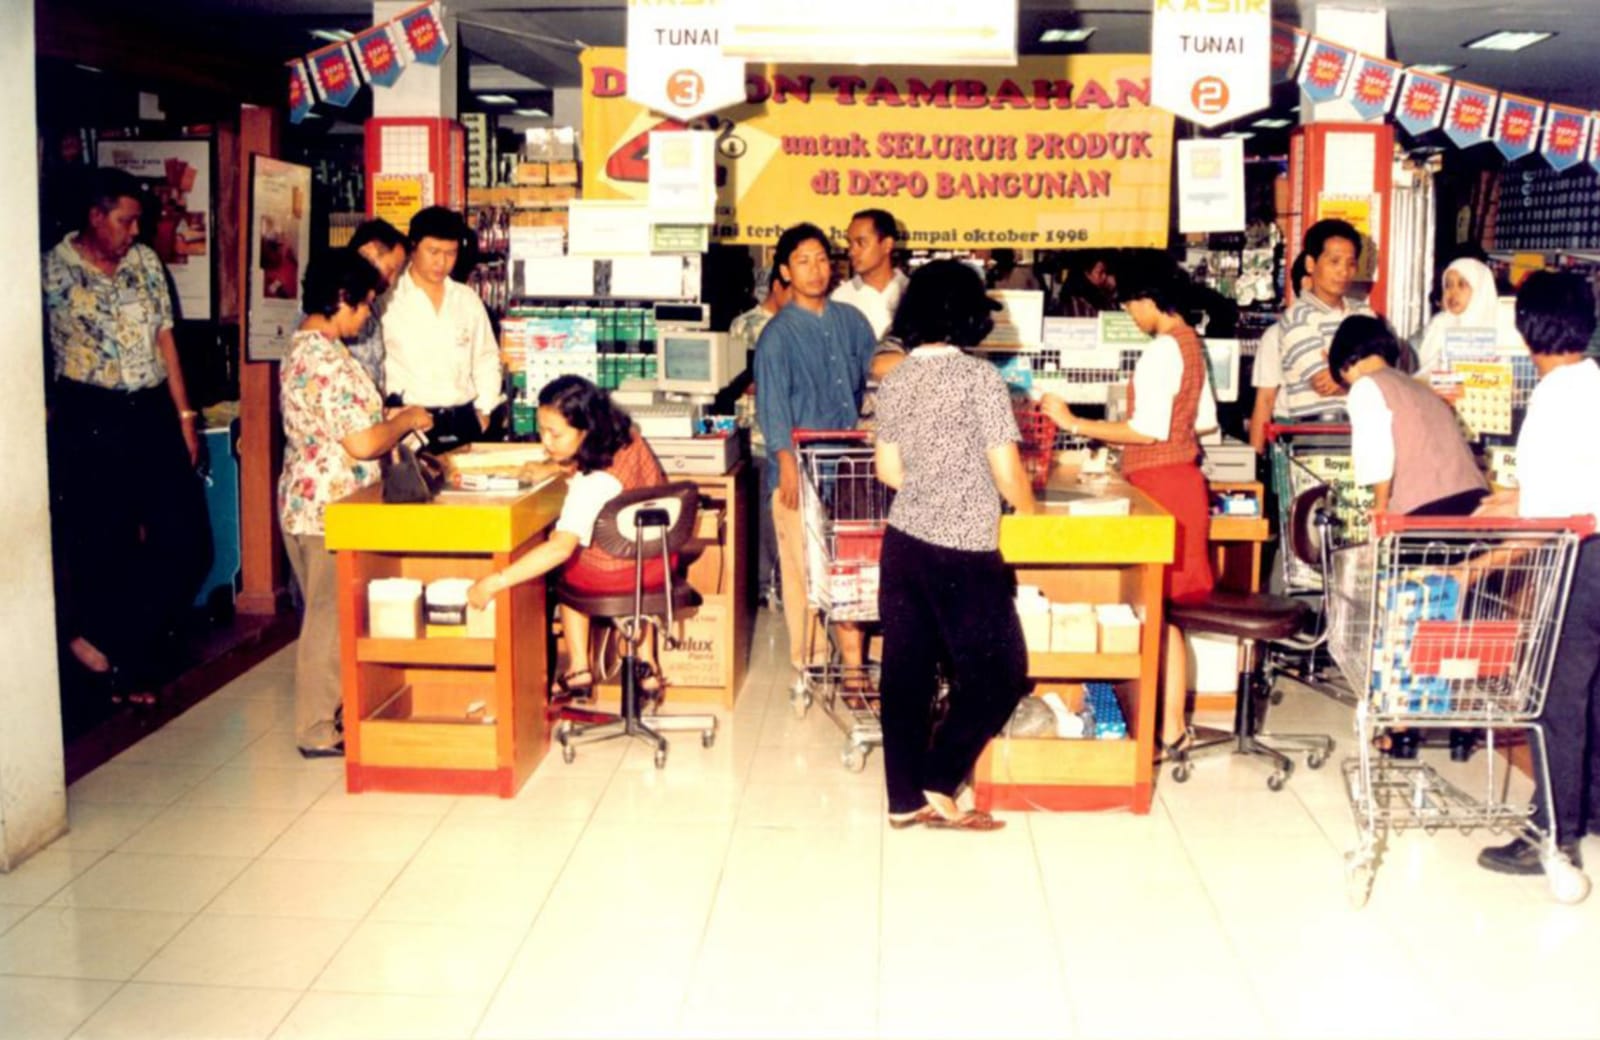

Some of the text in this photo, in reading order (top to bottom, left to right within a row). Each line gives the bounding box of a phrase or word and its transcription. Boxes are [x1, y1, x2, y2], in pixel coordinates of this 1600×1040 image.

[653, 28, 719, 46] TUNAI
[1179, 34, 1244, 54] TUNAI
[675, 73, 699, 104] 3
[828, 75, 1152, 110] TAMBAHAN
[1198, 81, 1222, 112] 2
[781, 131, 1153, 160] untuk SELURUH PRODUK
[810, 168, 1112, 199] di DEPO BANGUNAN
[963, 227, 1039, 243] oktober
[1046, 228, 1089, 242] 1998
